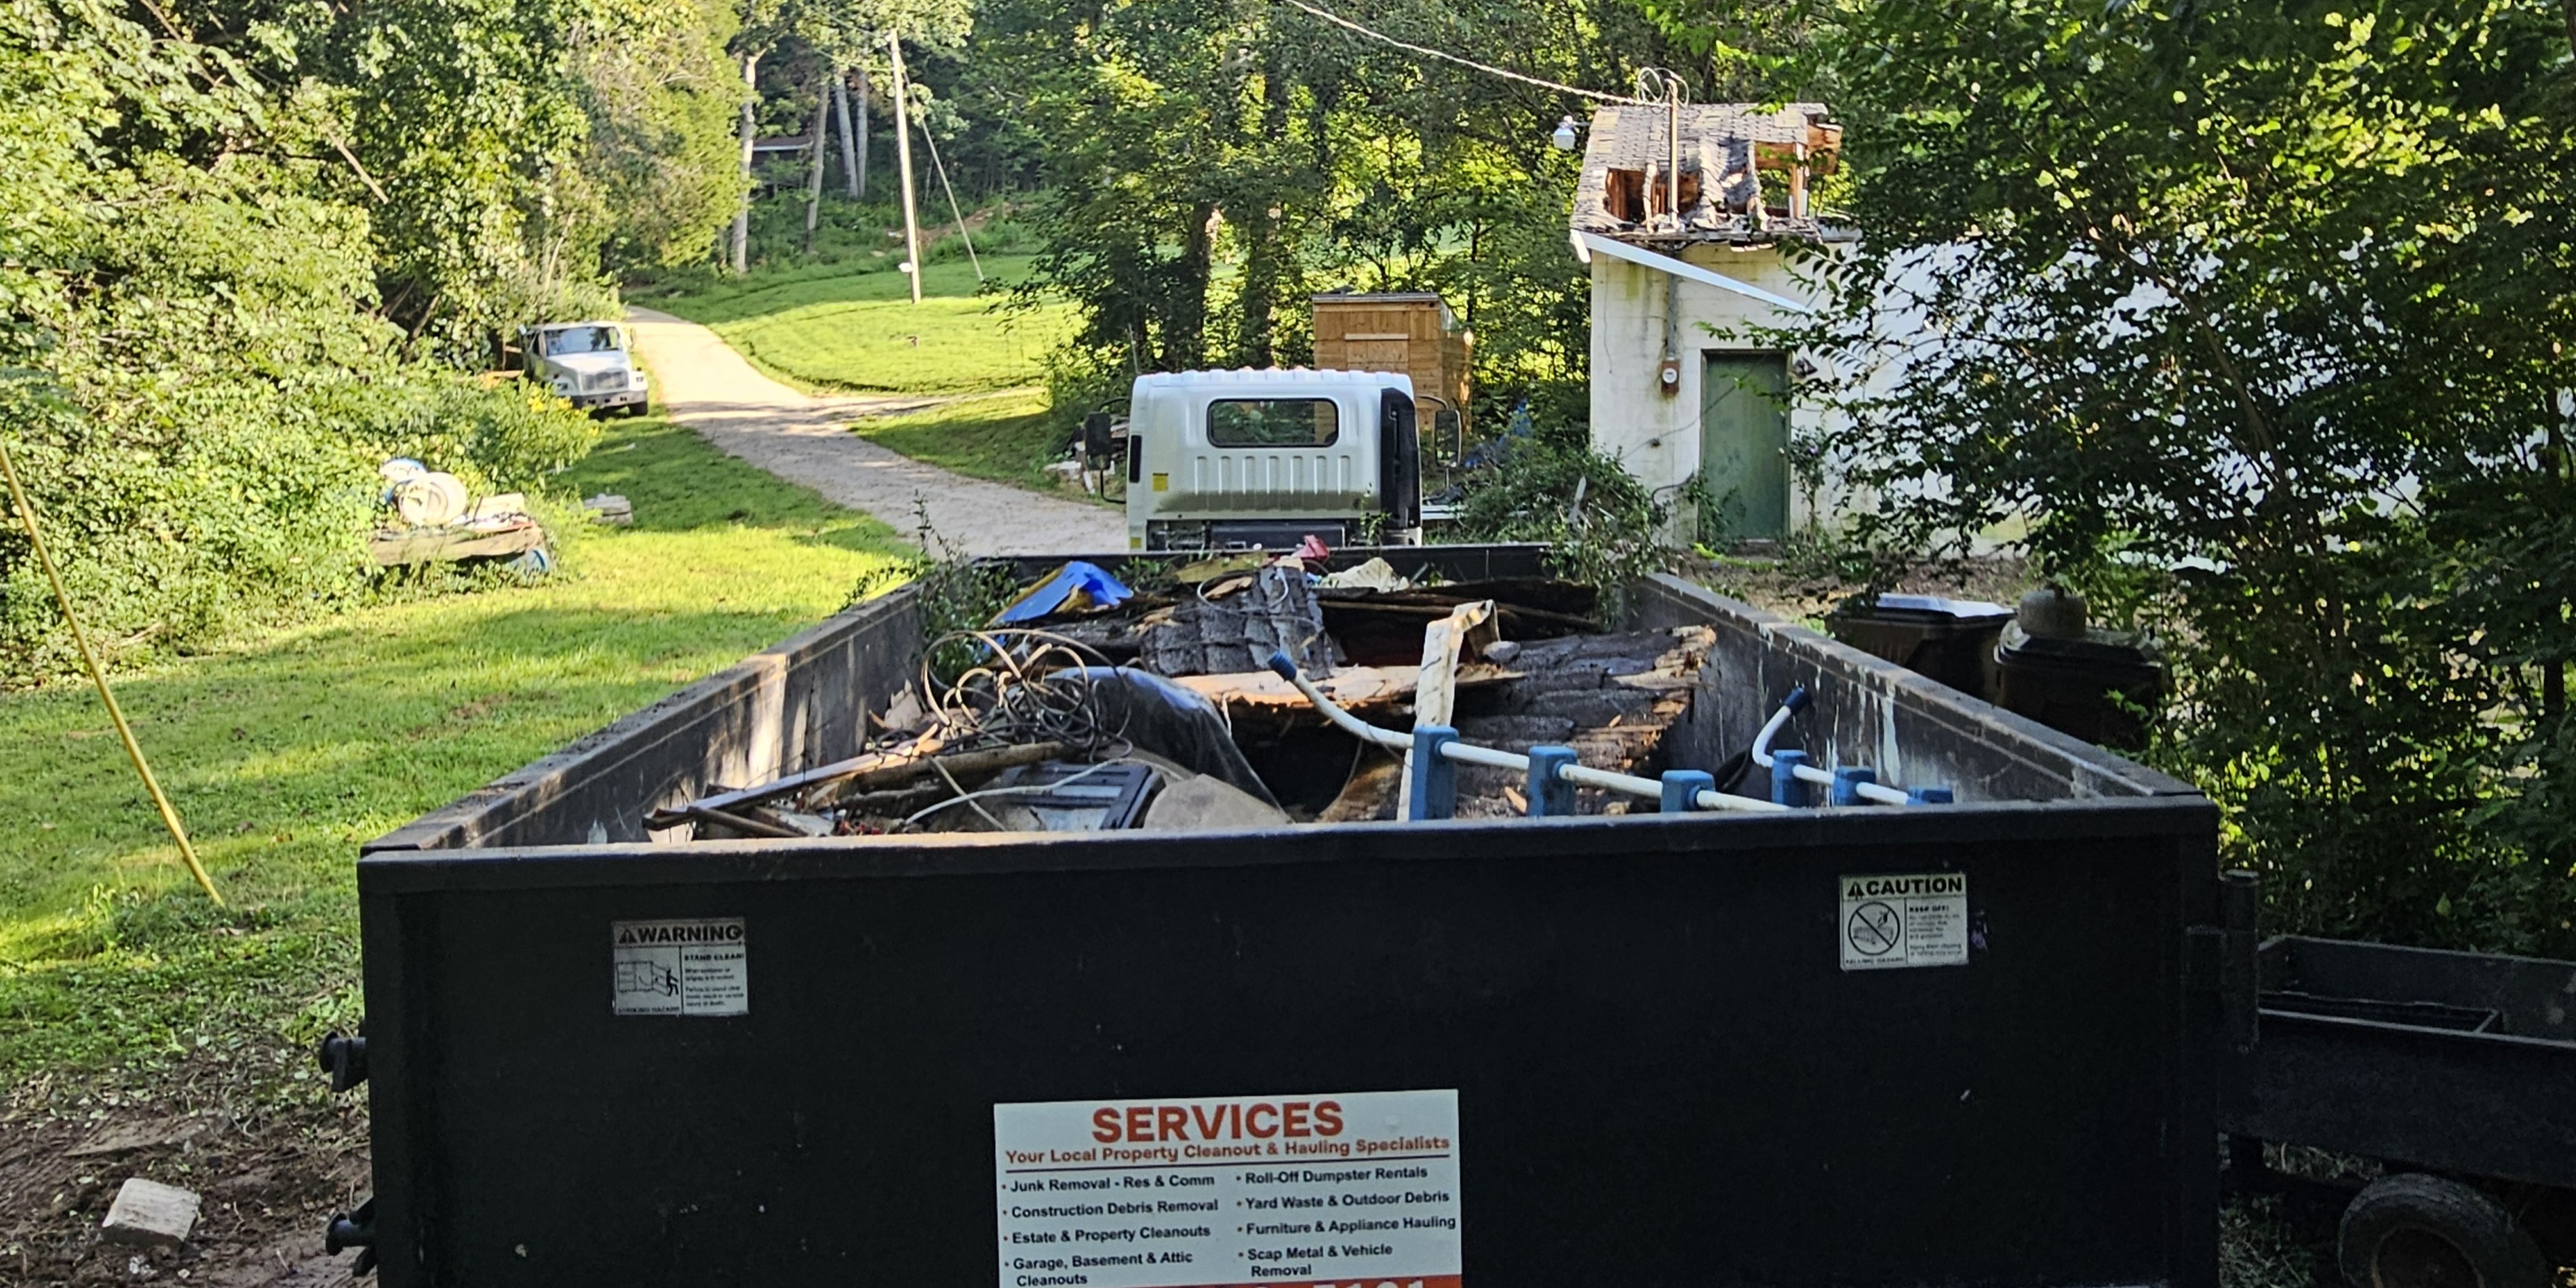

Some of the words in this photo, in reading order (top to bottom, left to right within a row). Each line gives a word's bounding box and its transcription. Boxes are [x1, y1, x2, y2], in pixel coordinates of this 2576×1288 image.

[1866, 877, 1962, 895] CAUTION
[637, 924, 743, 943] WARNING
[1091, 1100, 1344, 1144] SERVICES
[1006, 1149, 1045, 1164] Your
[1051, 1148, 1096, 1163] Local
[1102, 1145, 1179, 1163] Property
[1184, 1142, 1262, 1158] Cleanout
[1266, 1141, 1278, 1155] &
[1285, 1139, 1350, 1156] Hauling
[1356, 1136, 1450, 1155] Specialists
[1010, 1180, 1045, 1192] Junk
[1049, 1177, 1110, 1191] Removal
[1123, 1176, 1151, 1188] Res
[1154, 1175, 1165, 1188] &
[1169, 1175, 1215, 1188] Comm
[1245, 1171, 1299, 1184] Roll-Off
[1303, 1169, 1371, 1184] Dumpster
[1375, 1166, 1428, 1180] Rentals
[1012, 1203, 1104, 1218] Construction
[1107, 1201, 1153, 1215] Debris
[1157, 1198, 1219, 1213] Removal
[1245, 1196, 1278, 1209] Yard
[1282, 1196, 1324, 1209] Waste
[1327, 1195, 1338, 1207] &
[1342, 1192, 1401, 1207] Outdoor
[1405, 1190, 1450, 1204] Debris
[1012, 1231, 1057, 1244] Estate
[1060, 1230, 1071, 1243] &
[1075, 1228, 1136, 1244] Property
[1139, 1225, 1211, 1240] Cleanouts
[1247, 1222, 1311, 1235] Furniture
[1314, 1220, 1325, 1233] &
[1329, 1217, 1399, 1234] Appliance
[1403, 1215, 1456, 1230] Hauling
[1013, 1257, 1068, 1272] Garage,
[1072, 1253, 1144, 1268] Basement
[1146, 1252, 1156, 1265] &
[1160, 1251, 1193, 1264] Attic
[1247, 1248, 1283, 1262] Scap
[1286, 1246, 1323, 1260] Metal
[1327, 1245, 1338, 1257] &
[1342, 1243, 1392, 1257] Vehicle
[1017, 1274, 1088, 1287] Cleanouts
[1251, 1264, 1312, 1278] Removal
